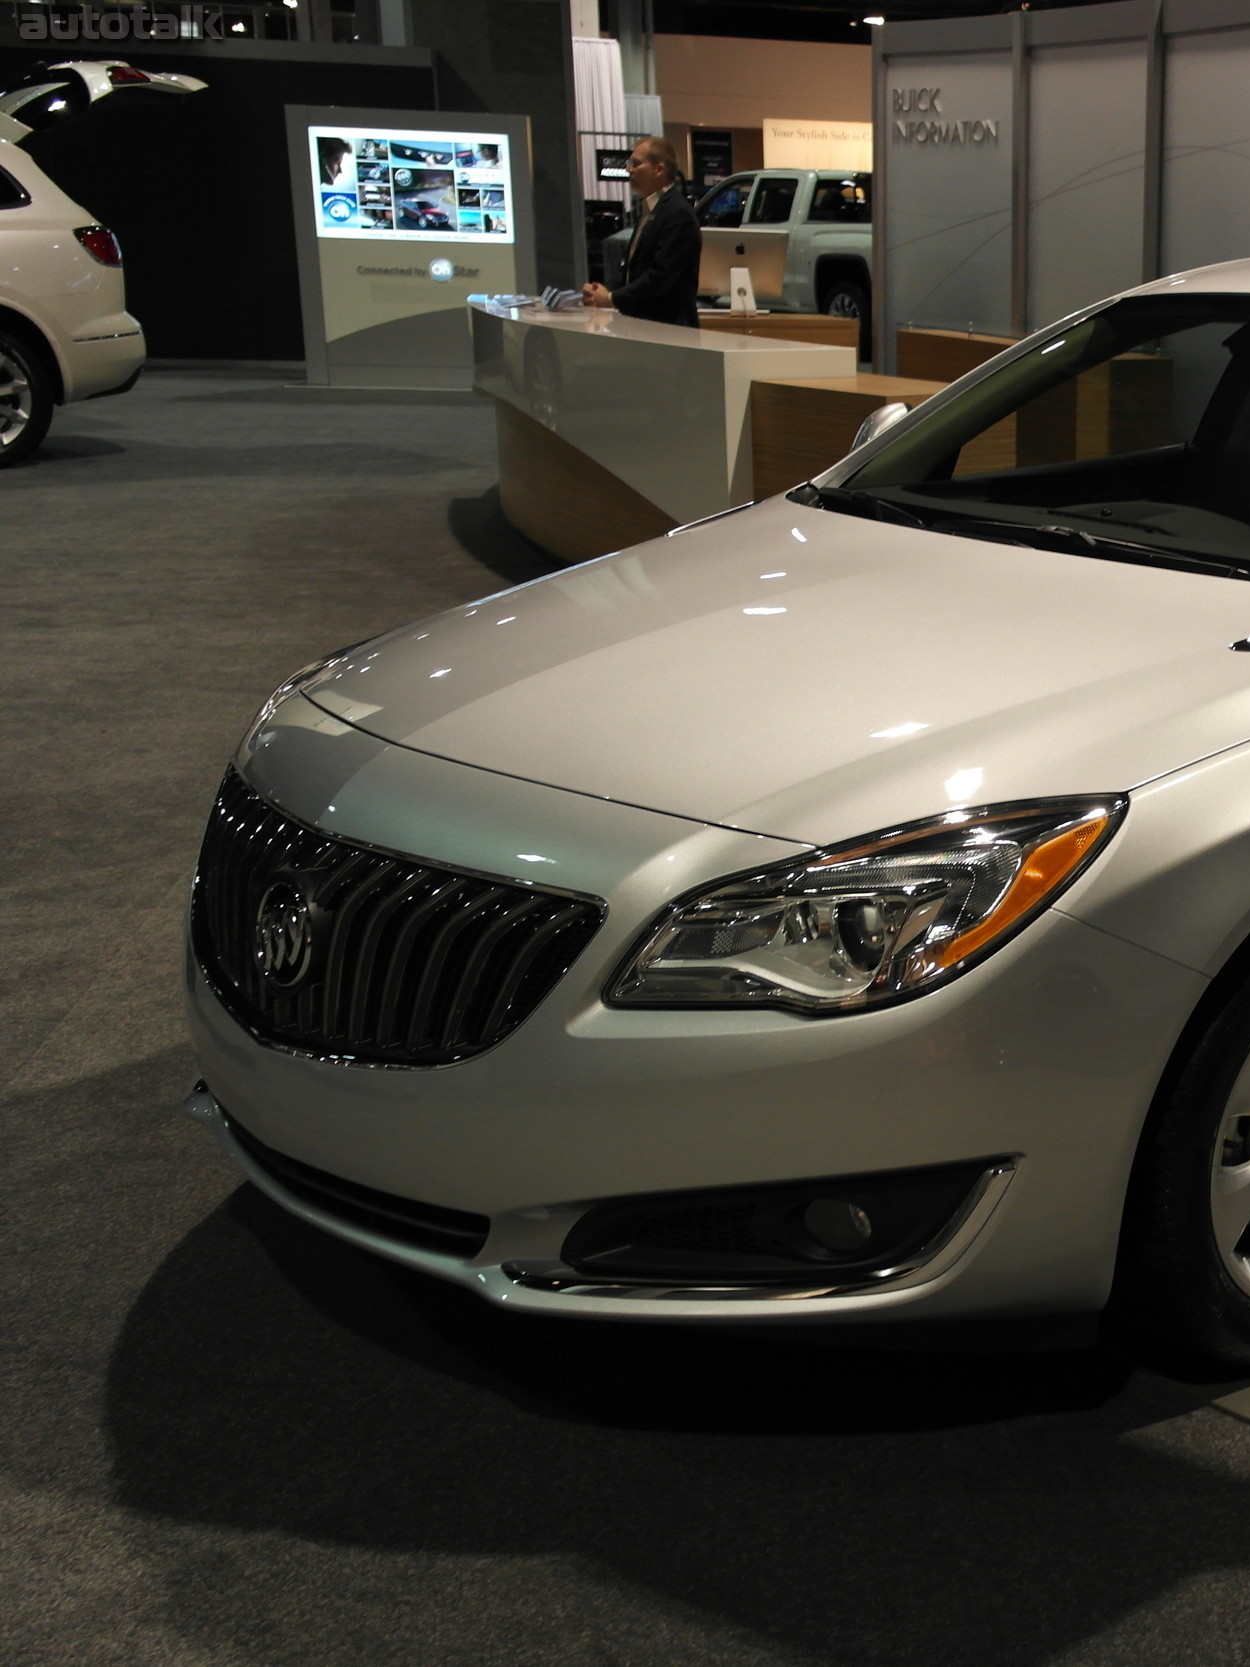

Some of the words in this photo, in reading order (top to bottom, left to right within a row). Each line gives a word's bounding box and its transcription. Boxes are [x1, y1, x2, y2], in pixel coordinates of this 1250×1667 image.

[892, 88, 943, 112] BUICK
[772, 127, 794, 138] Your
[796, 129, 828, 142] Stylish
[830, 130, 849, 141] Side
[892, 119, 999, 143] INFORMATION
[356, 265, 412, 276] Connected
[414, 266, 426, 278] by
